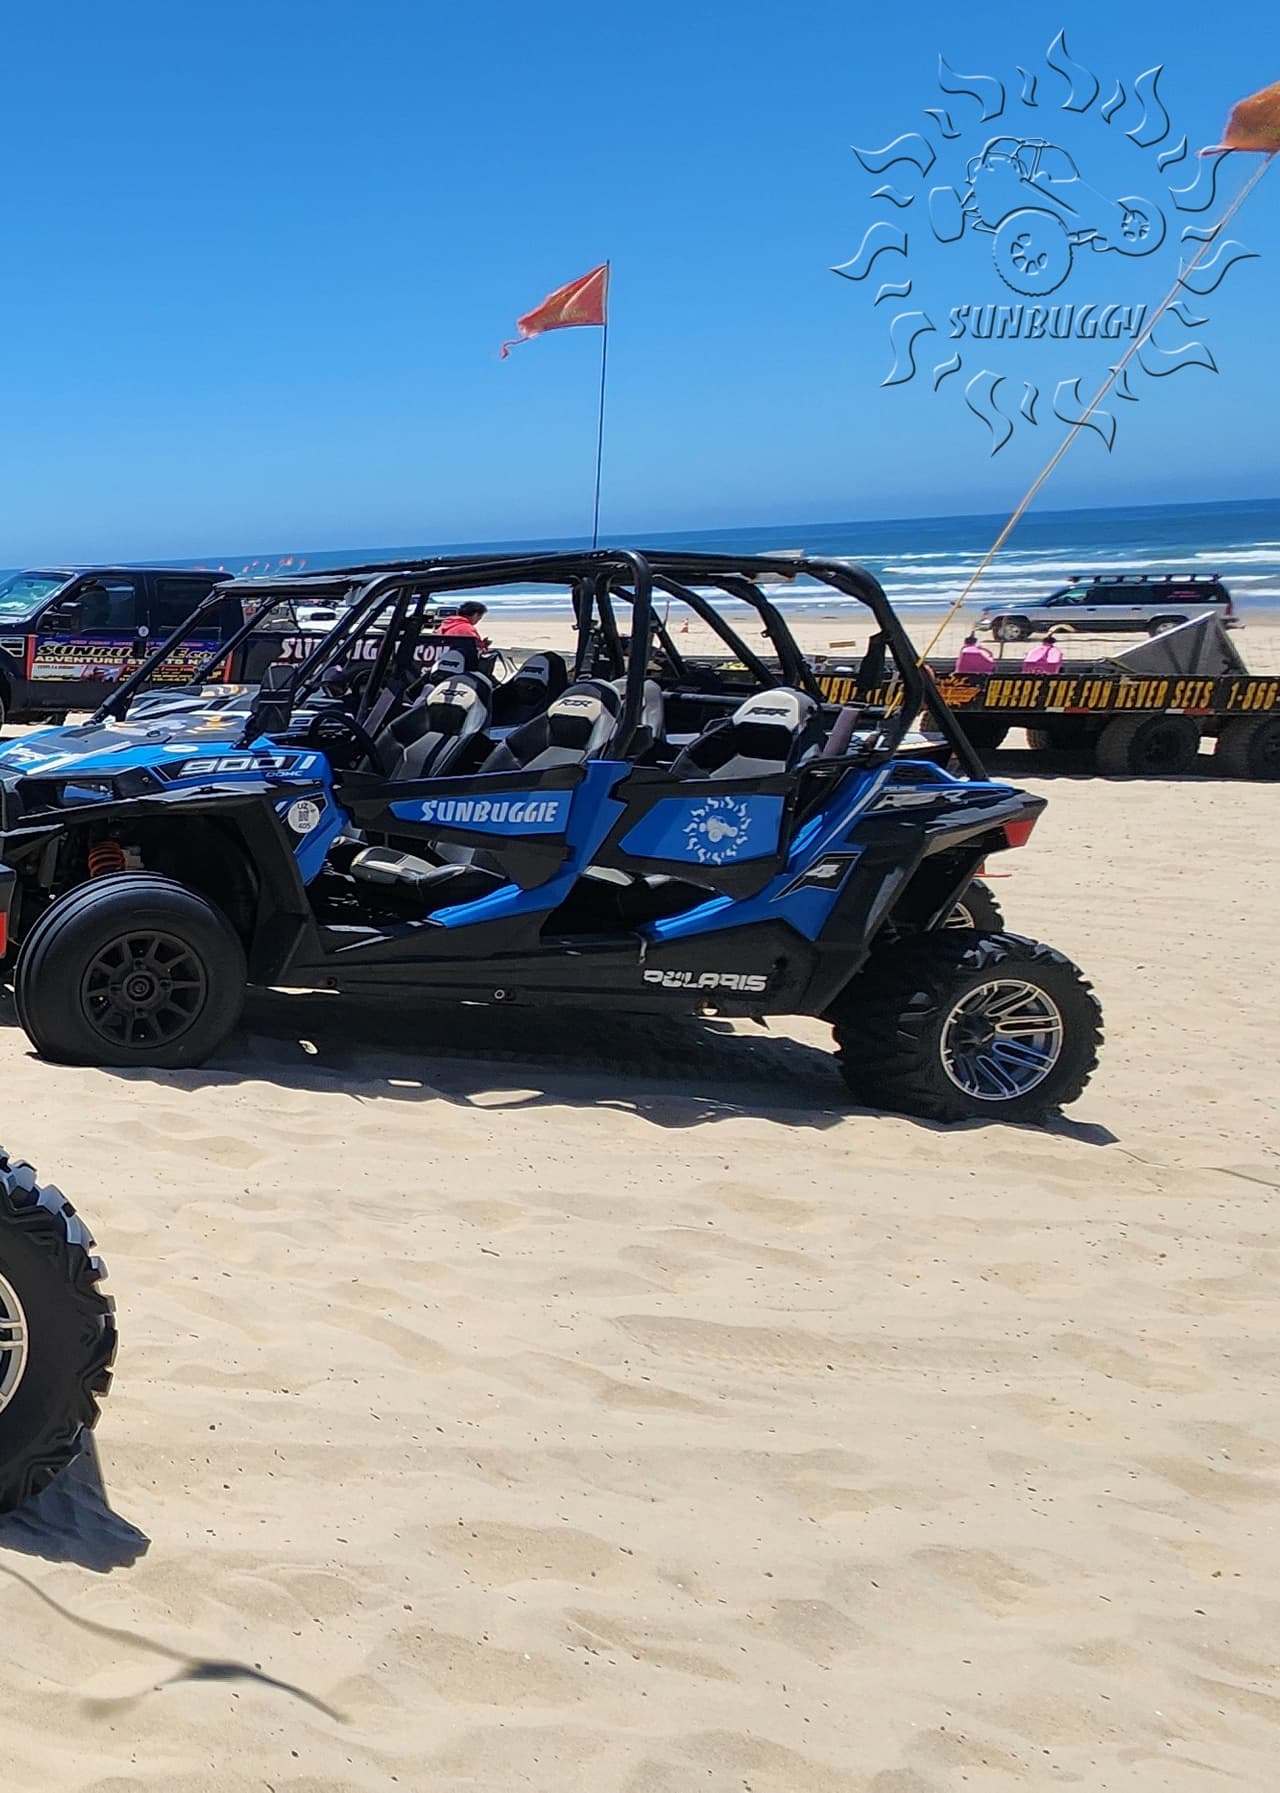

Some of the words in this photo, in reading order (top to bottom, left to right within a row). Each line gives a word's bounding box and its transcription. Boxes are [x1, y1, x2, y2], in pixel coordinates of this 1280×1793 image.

[34, 656, 123, 665] ADVENTURE
[985, 679, 1042, 708] WHERE
[1044, 680, 1077, 708] THE
[1078, 680, 1113, 709] FUN
[1114, 680, 1169, 709] NEVER
[1170, 680, 1215, 709] SETS
[177, 756, 286, 778] 900
[265, 770, 304, 778] DOHC
[419, 800, 559, 823] SUNBUGGIE
[643, 969, 769, 993] POLARIS
